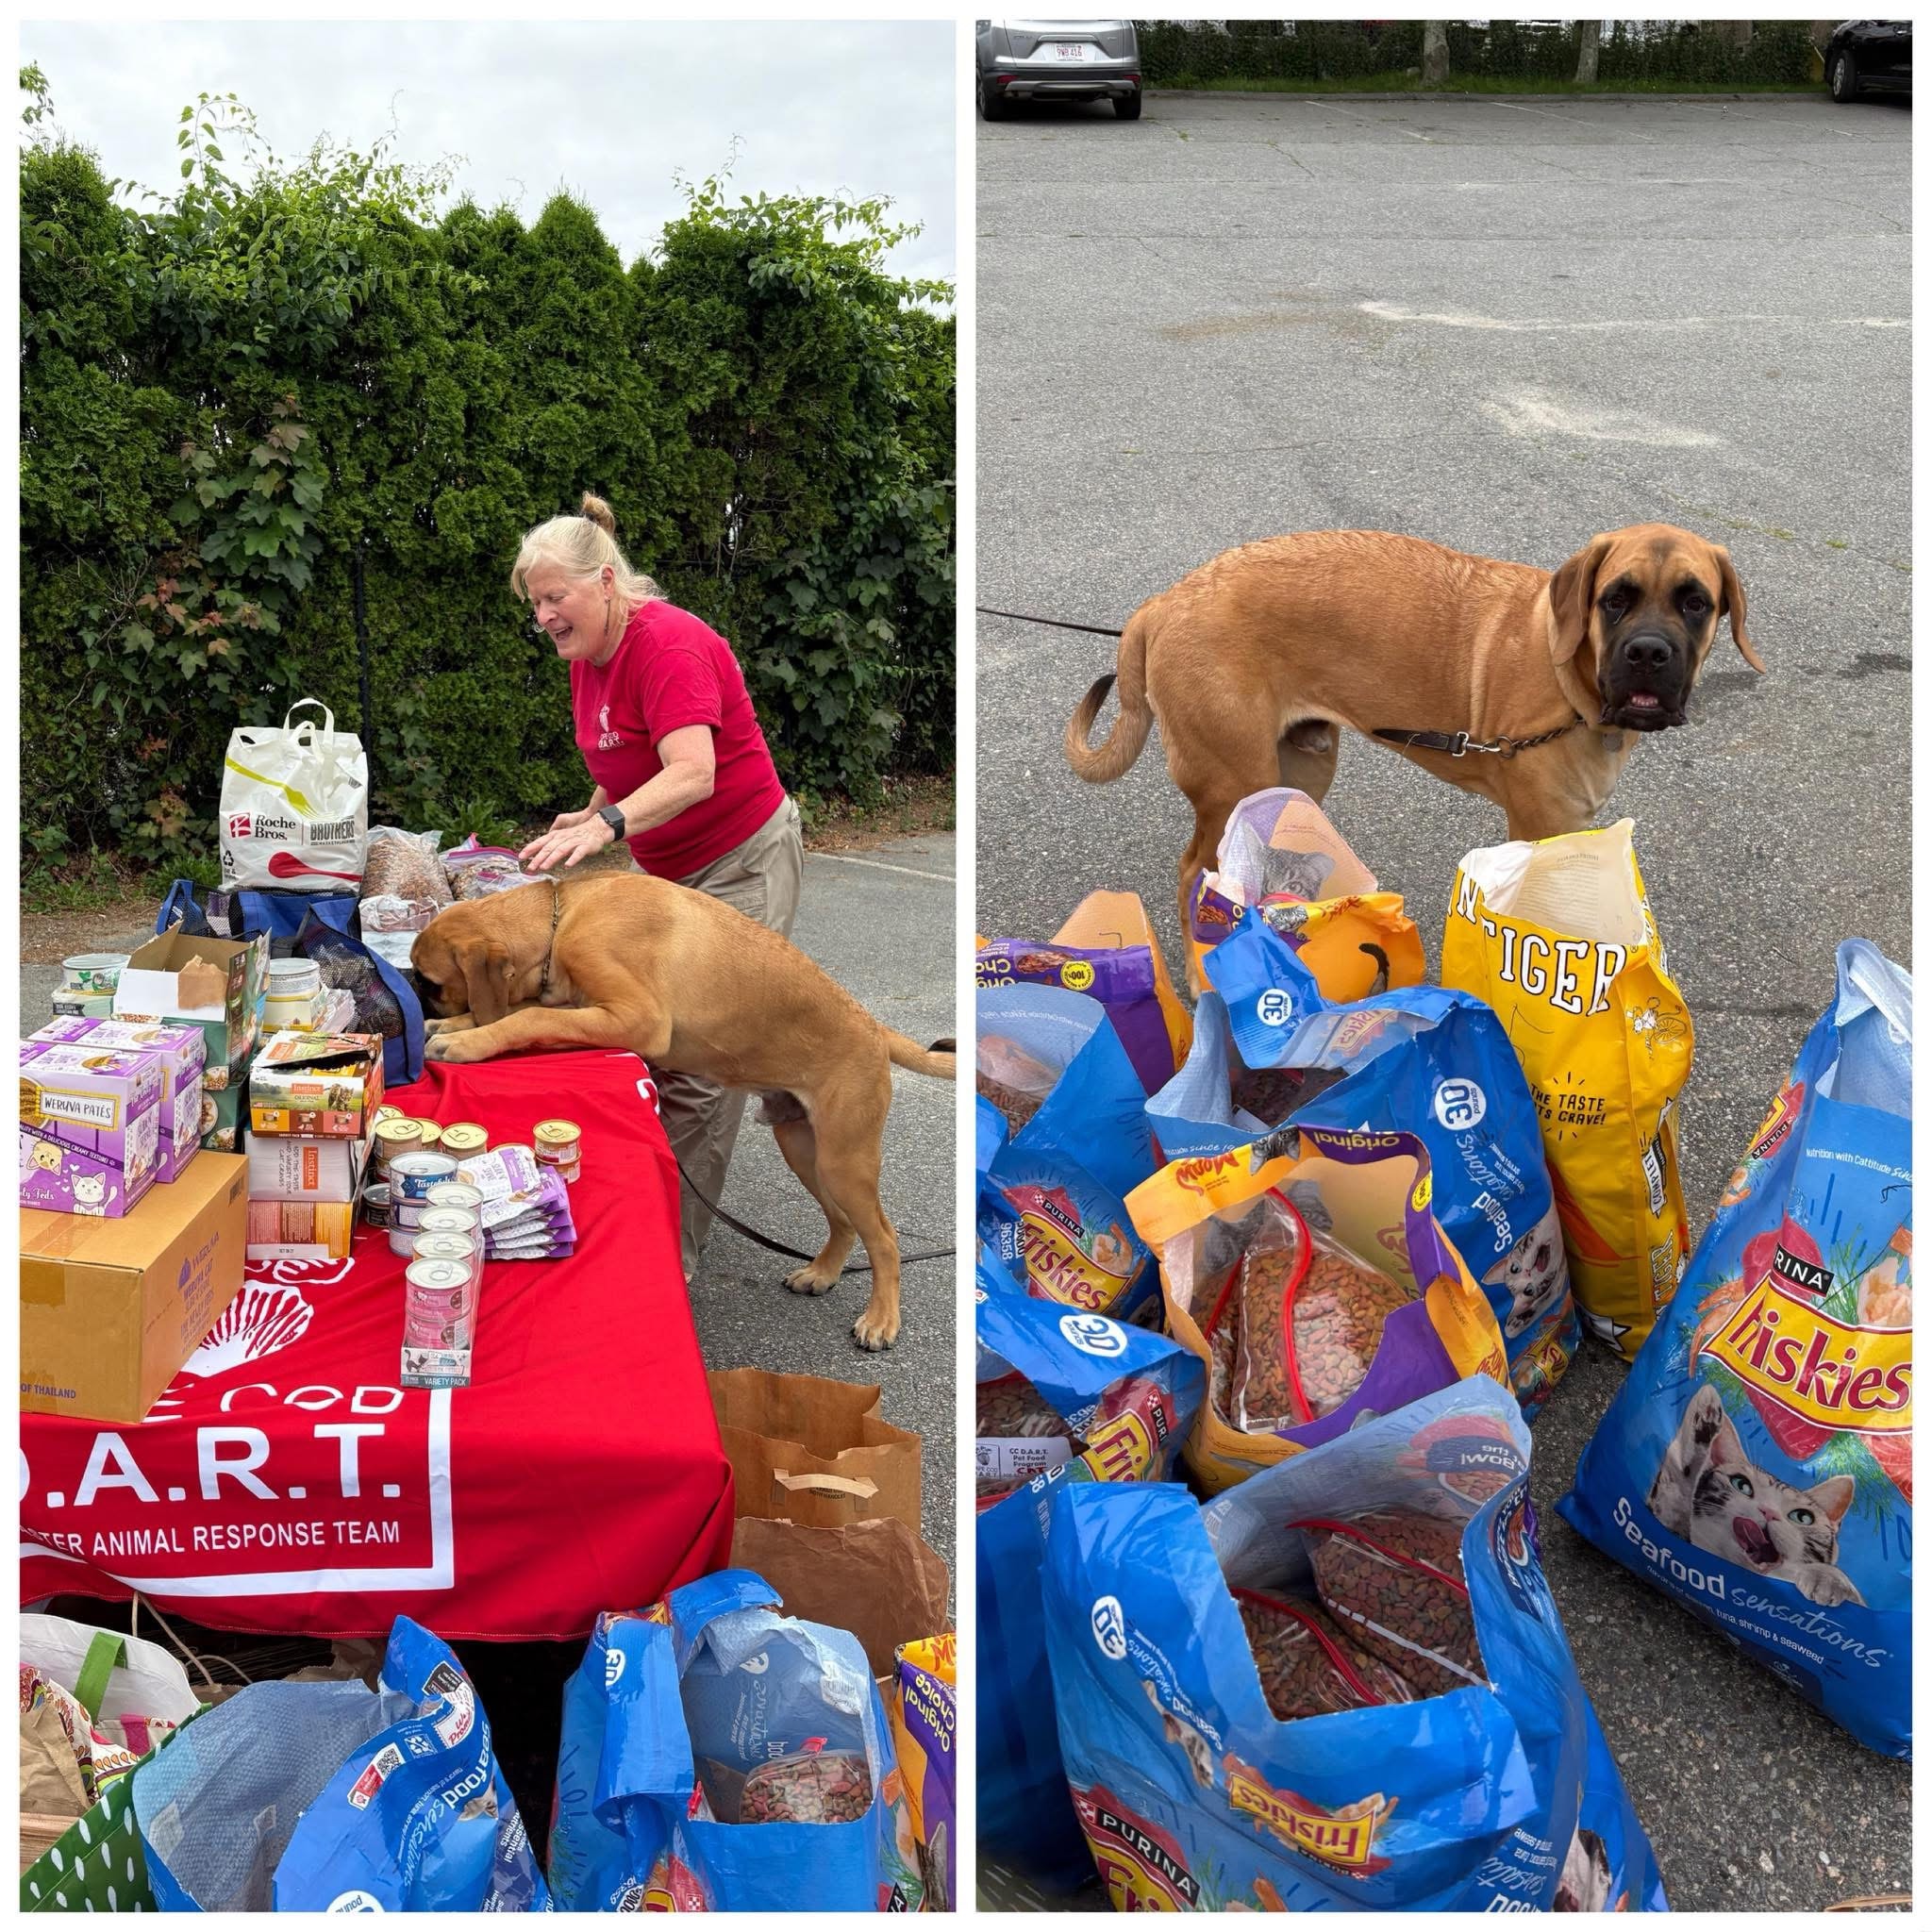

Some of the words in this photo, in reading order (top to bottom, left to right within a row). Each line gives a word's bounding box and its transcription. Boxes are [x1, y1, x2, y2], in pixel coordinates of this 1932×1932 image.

[255, 814, 296, 830] Roche
[255, 827, 288, 841] Bros.
[310, 820, 355, 841] BROTHERS
[1261, 993, 1283, 1022] 30
[44, 1098, 81, 1115] WERUVA
[1441, 1083, 1470, 1124] 30
[1533, 1102, 1554, 1124] TS
[1557, 1108, 1607, 1127] CRAVE!
[1558, 1092, 1606, 1113] TASTE
[32, 1127, 44, 1138] WITH
[48, 1133, 70, 1149] DELICIOUS
[72, 1141, 90, 1157] CREAMY
[1313, 1132, 1400, 1150] Original
[1752, 1120, 1789, 1159] PURINA
[308, 1150, 318, 1186] Instinct
[1645, 1153, 1663, 1213] COMPLET
[1835, 1152, 1853, 1166] with
[1855, 1154, 1891, 1175] Cattitude
[1891, 1166, 1912, 1184] Sinc
[1043, 1200, 1083, 1237] PURINA
[1471, 1191, 1513, 1252] Seafood
[1000, 1222, 1014, 1262] 96358
[1024, 1217, 1108, 1312] Friskies
[1072, 1317, 1121, 1353] 30
[21, 1383, 33, 1394] OF
[34, 1384, 77, 1399] THAILAND
[424, 1377, 450, 1386] VARIETY
[450, 1377, 466, 1387] PACK
[1094, 1426, 1145, 1482] Fri
[92, 1527, 185, 1557] ANIMAL
[193, 1521, 326, 1552] RESPONSE
[333, 1520, 400, 1545] TEAM
[1614, 1497, 1725, 1599] Seafood
[1731, 1588, 1887, 1668] sensations
[1715, 1610, 1737, 1626] tuna,
[1738, 1619, 1771, 1641] shrimp
[1772, 1632, 1779, 1642] &
[1780, 1636, 1824, 1665] seaweed
[905, 1685, 950, 1753] Original
[916, 1674, 955, 1731] Choice
[441, 1721, 491, 1810] Seafood
[1240, 1785, 1358, 1859] Friskies
[504, 1818, 525, 1864] ssential
[1101, 1814, 1192, 1898] PURINA
[335, 1894, 363, 1912] poun
